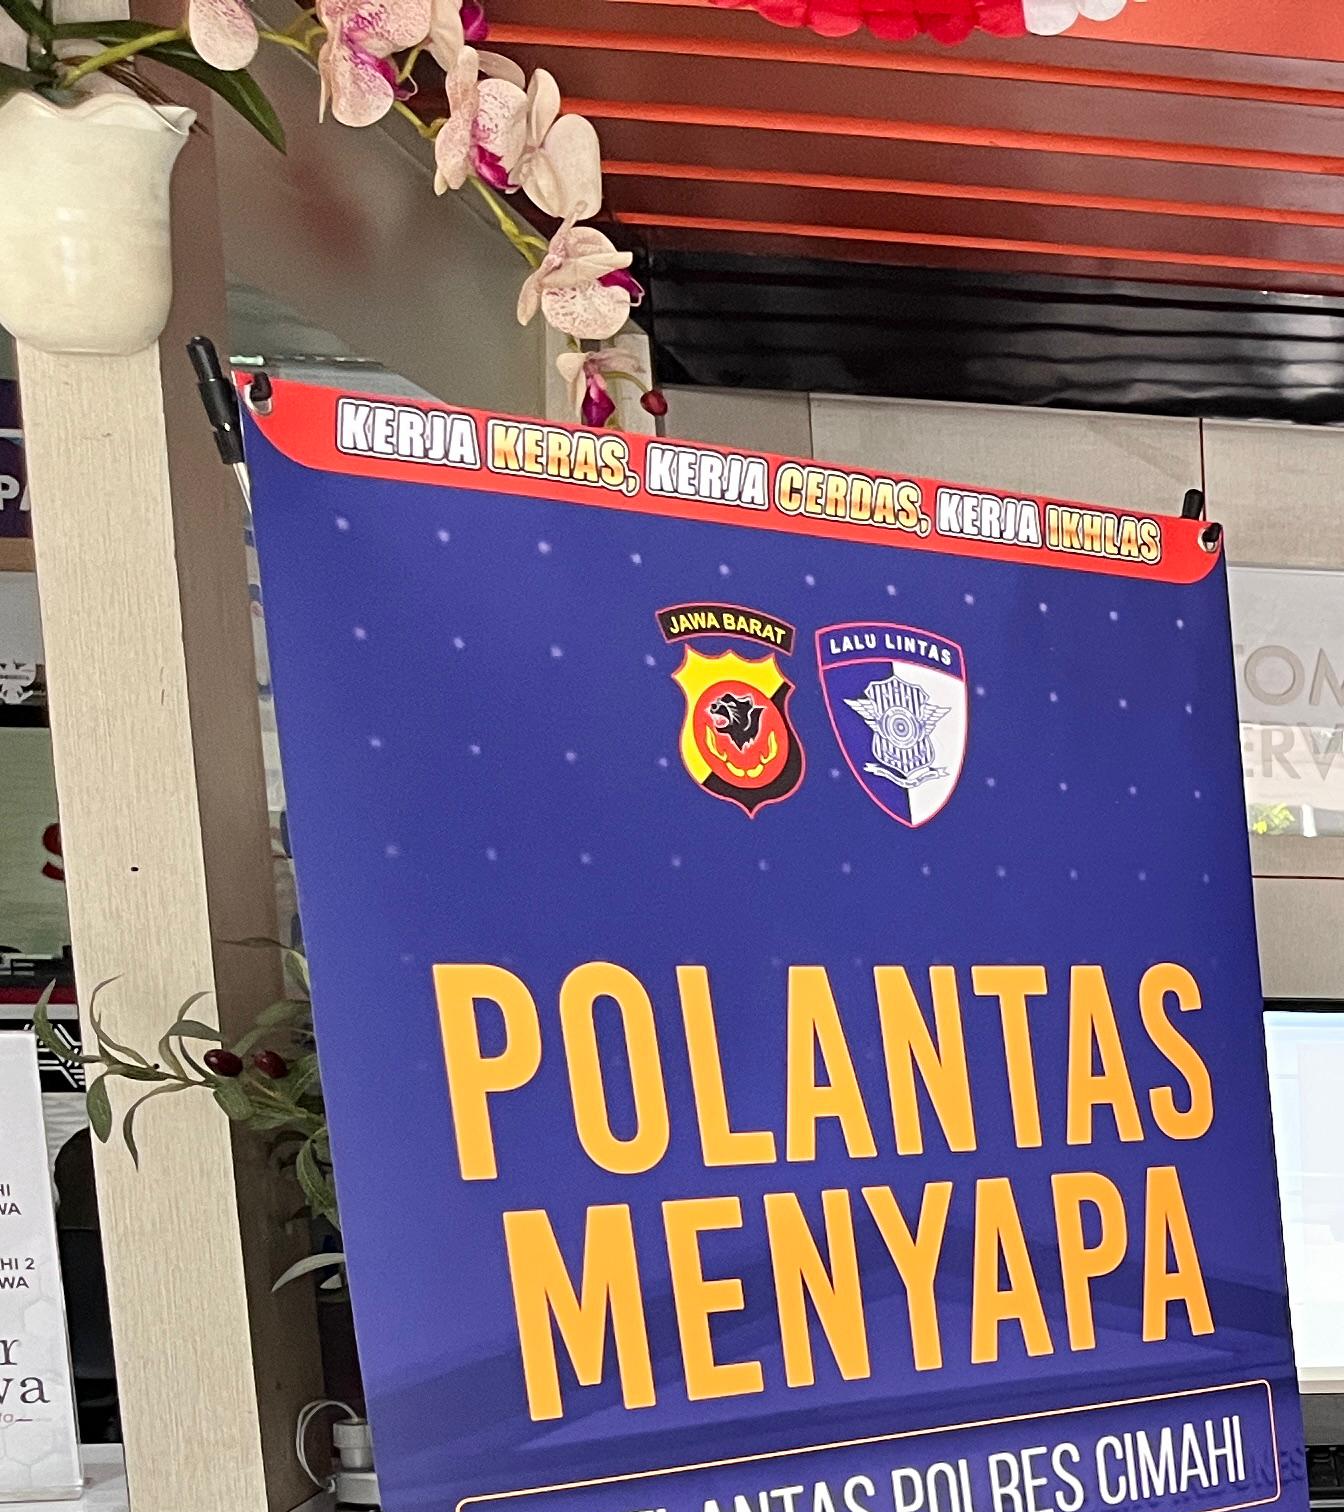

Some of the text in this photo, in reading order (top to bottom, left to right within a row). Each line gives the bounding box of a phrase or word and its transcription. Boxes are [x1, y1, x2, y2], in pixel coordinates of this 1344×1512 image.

[338, 397, 1160, 563] KERJA KERAS, KERJA CERDAS, KERJA IKHLAS
[669, 612, 786, 645] JAWA BARAT
[830, 633, 952, 666] LALU LINTAS
[431, 961, 1214, 1181] POLANTAS
[25, 1257, 35, 1270] 2
[502, 1165, 1214, 1422] MENYAPA
[1095, 1415, 1247, 1507] CIMAHI
